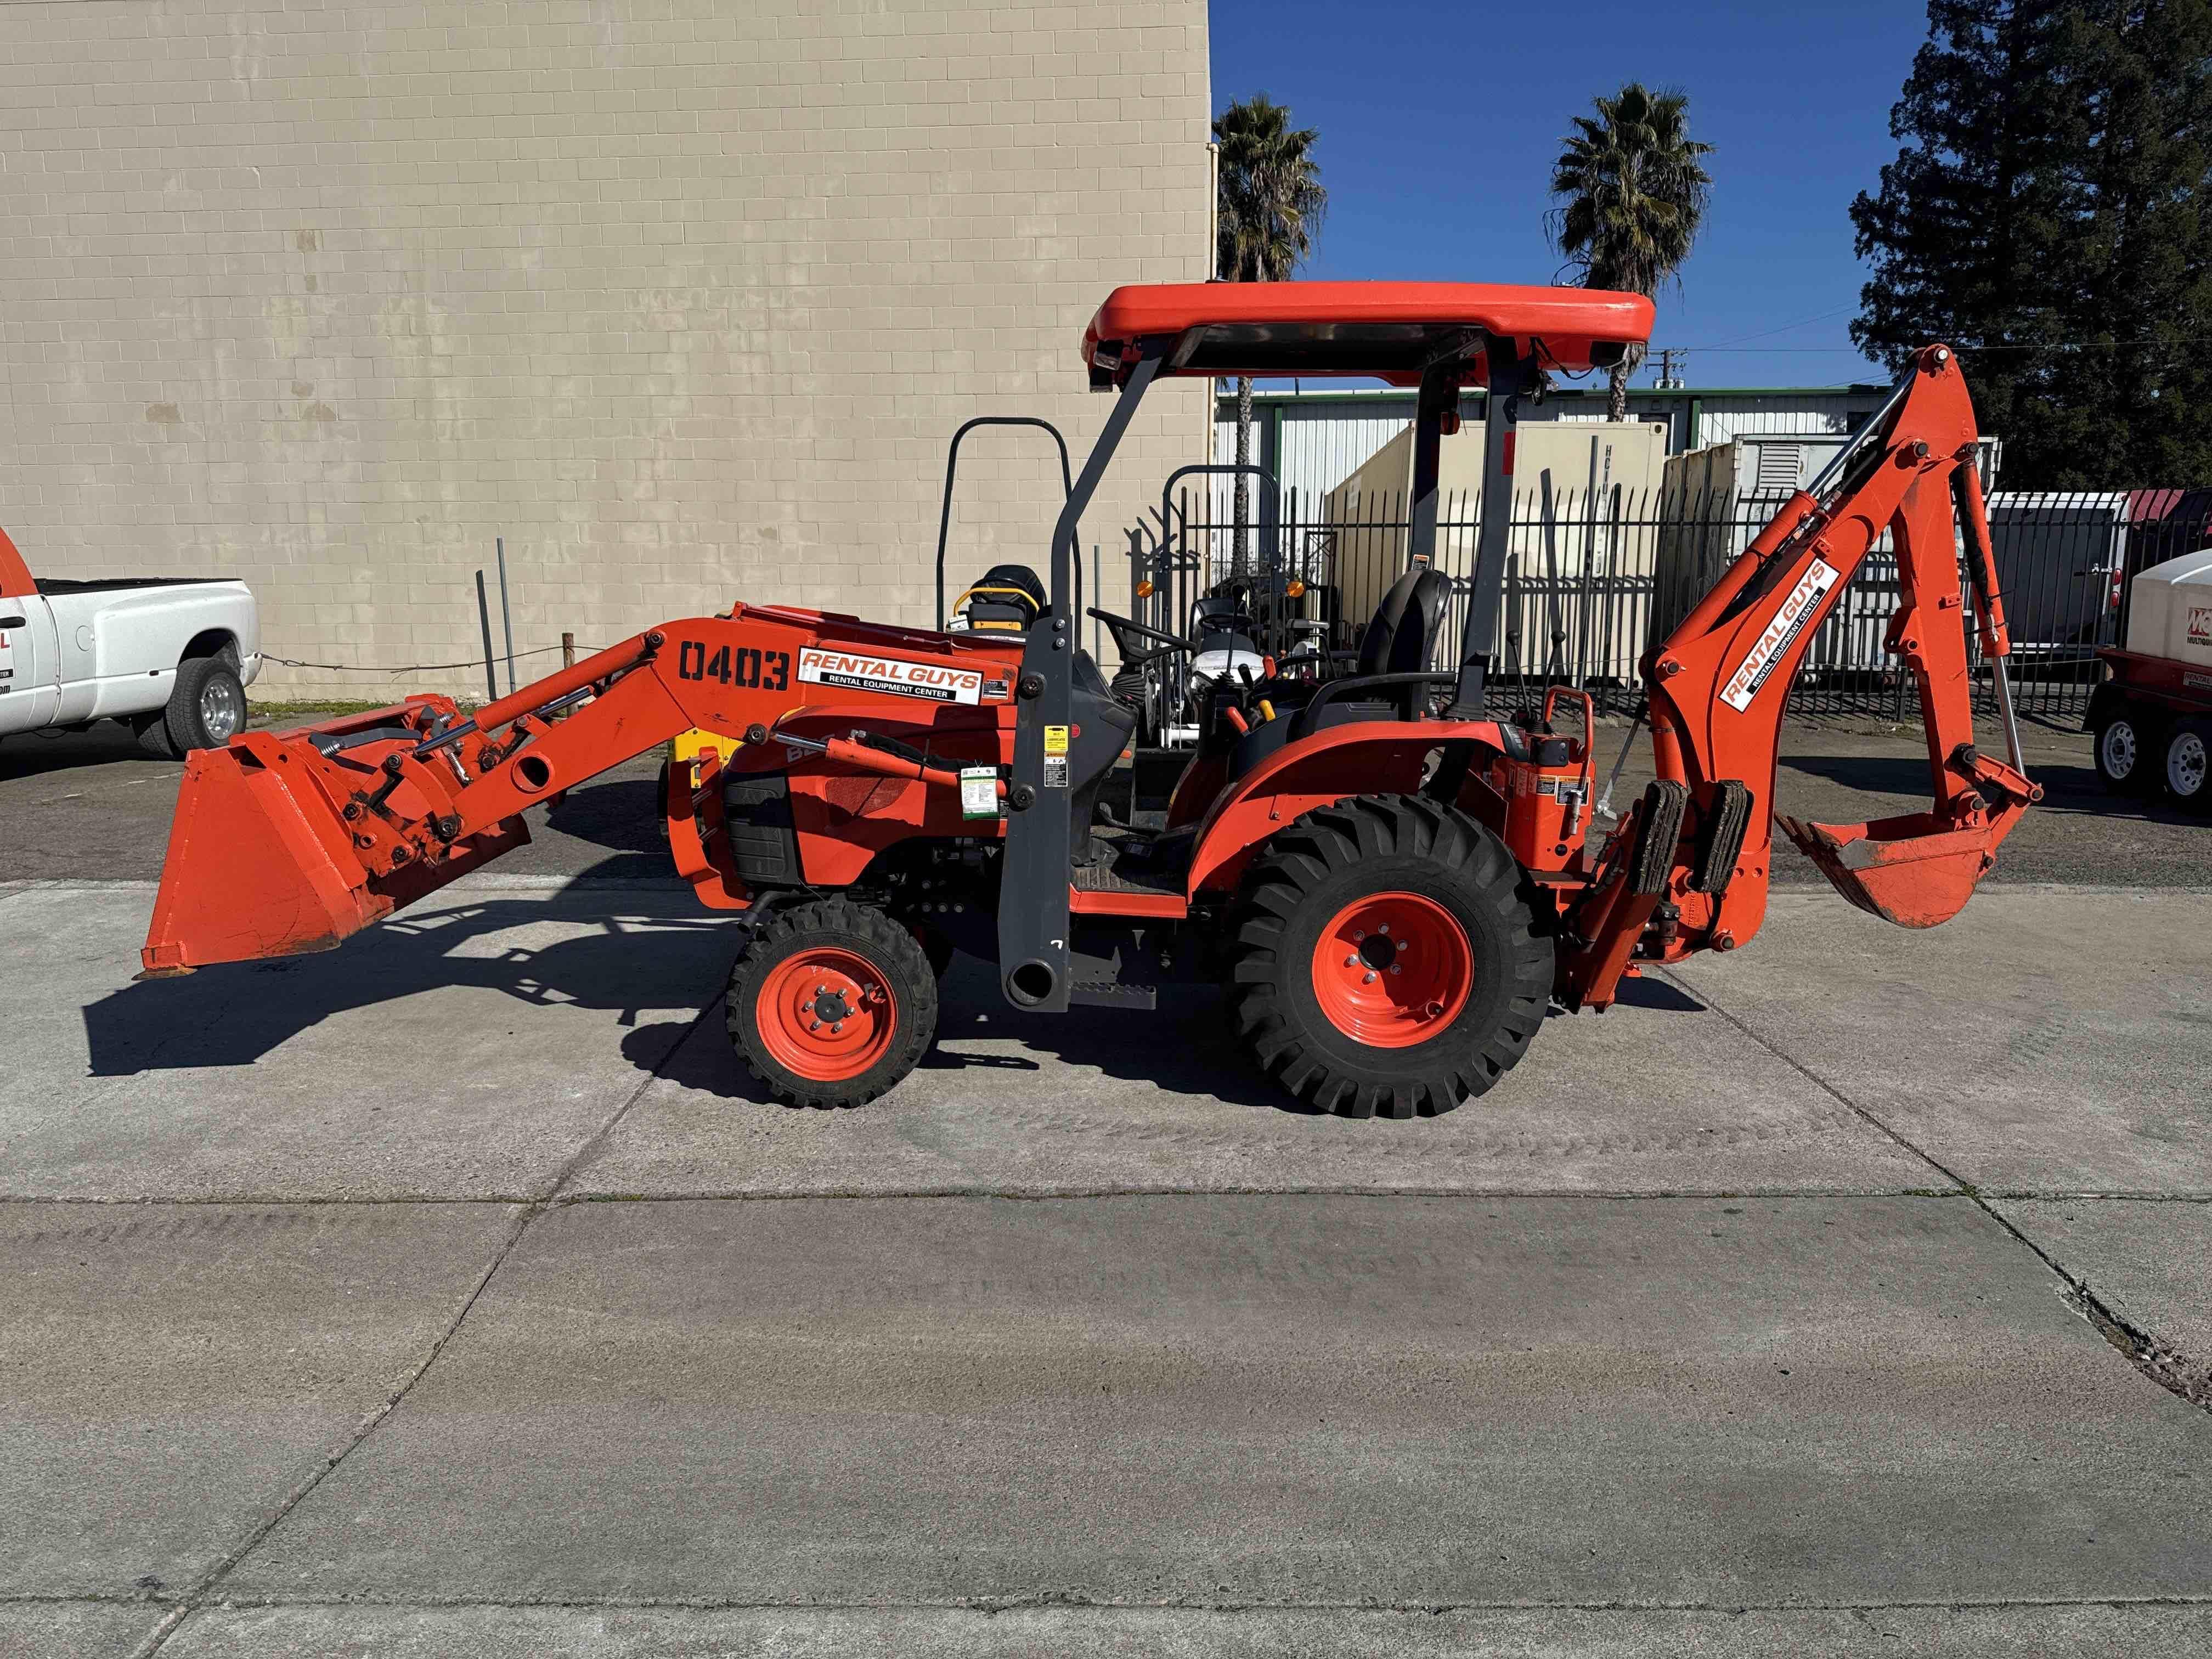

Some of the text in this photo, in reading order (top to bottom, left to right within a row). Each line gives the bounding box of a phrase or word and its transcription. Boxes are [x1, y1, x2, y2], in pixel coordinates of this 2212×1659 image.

[1602, 444, 1612, 494] HCIU
[1726, 562, 1825, 703] RENTAL GUYS
[1752, 594, 1820, 687] RENTAL EQUIPMENT CENTER
[679, 640, 790, 691] 0403
[802, 652, 904, 680] RENTAL
[907, 667, 979, 690] GUYS
[829, 675, 949, 698] RENTAL EQUIPMENT CENTER
